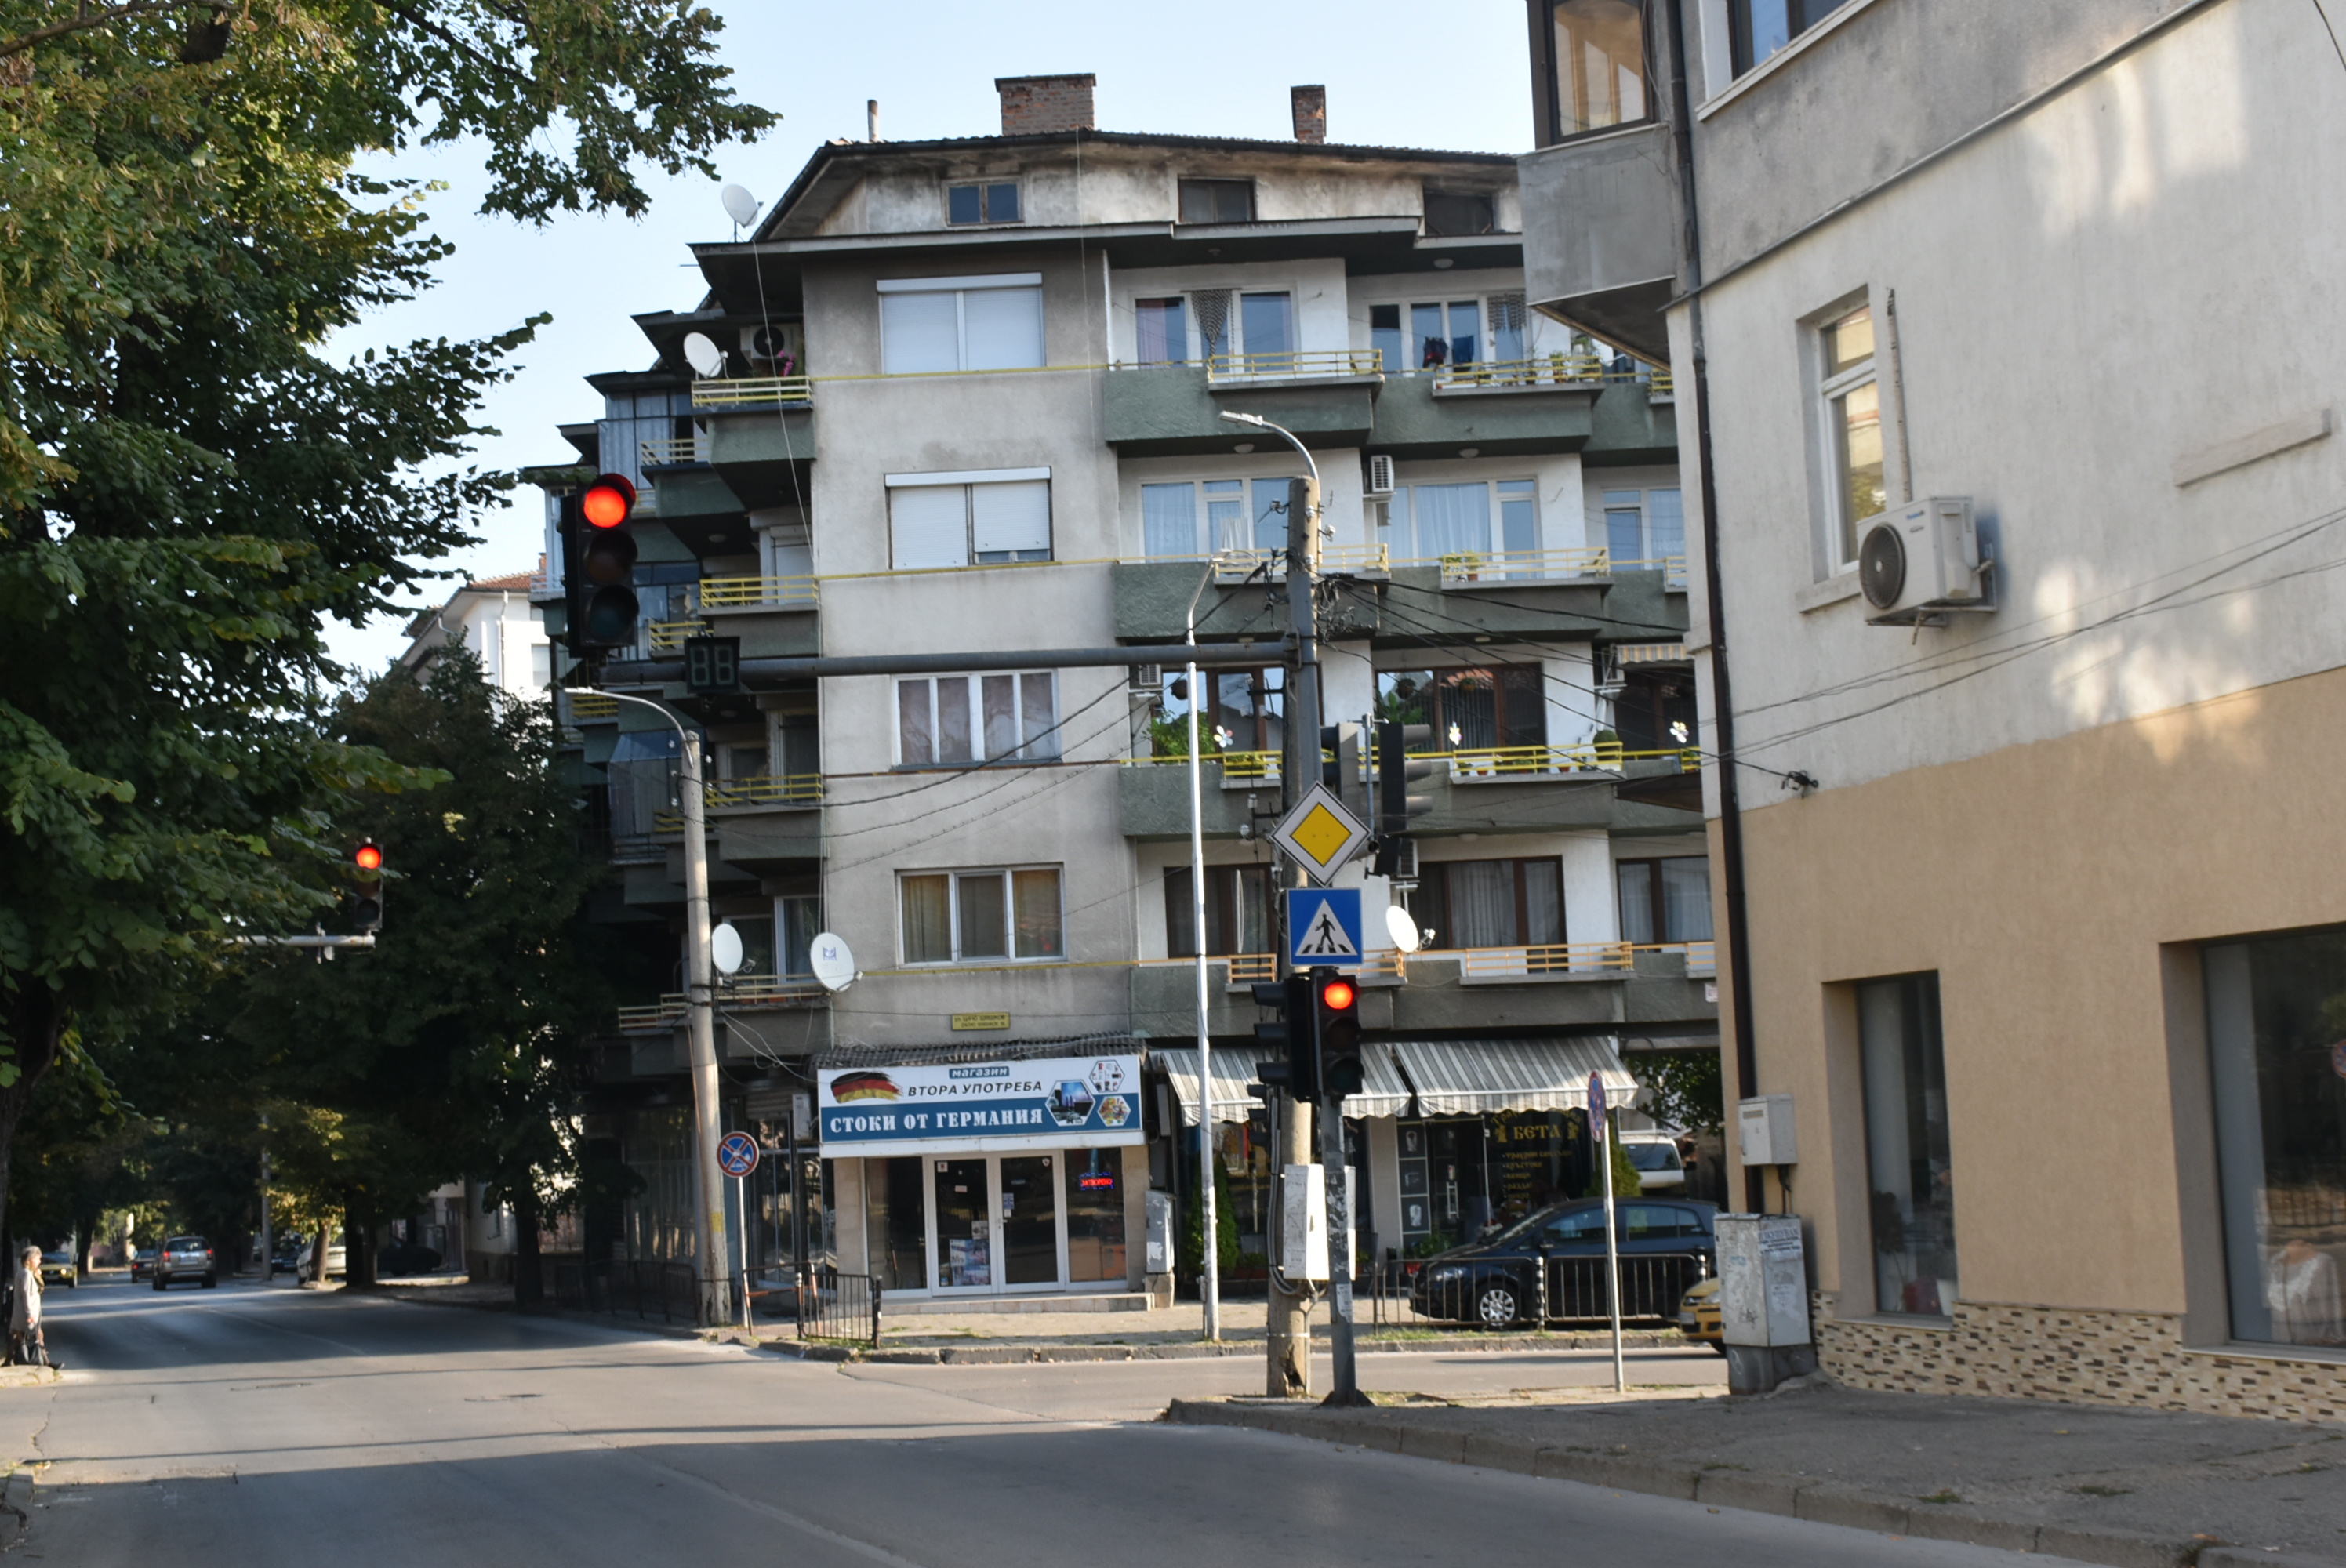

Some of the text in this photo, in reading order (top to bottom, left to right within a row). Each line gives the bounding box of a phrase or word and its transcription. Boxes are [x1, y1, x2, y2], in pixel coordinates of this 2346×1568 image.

[951, 1067, 1008, 1078] магазин
[908, 1081, 1042, 1097] ВТОРА УПОТРЕБА
[830, 1109, 1043, 1133] СТОКИ ОТ ГЕРМАНИЯ
